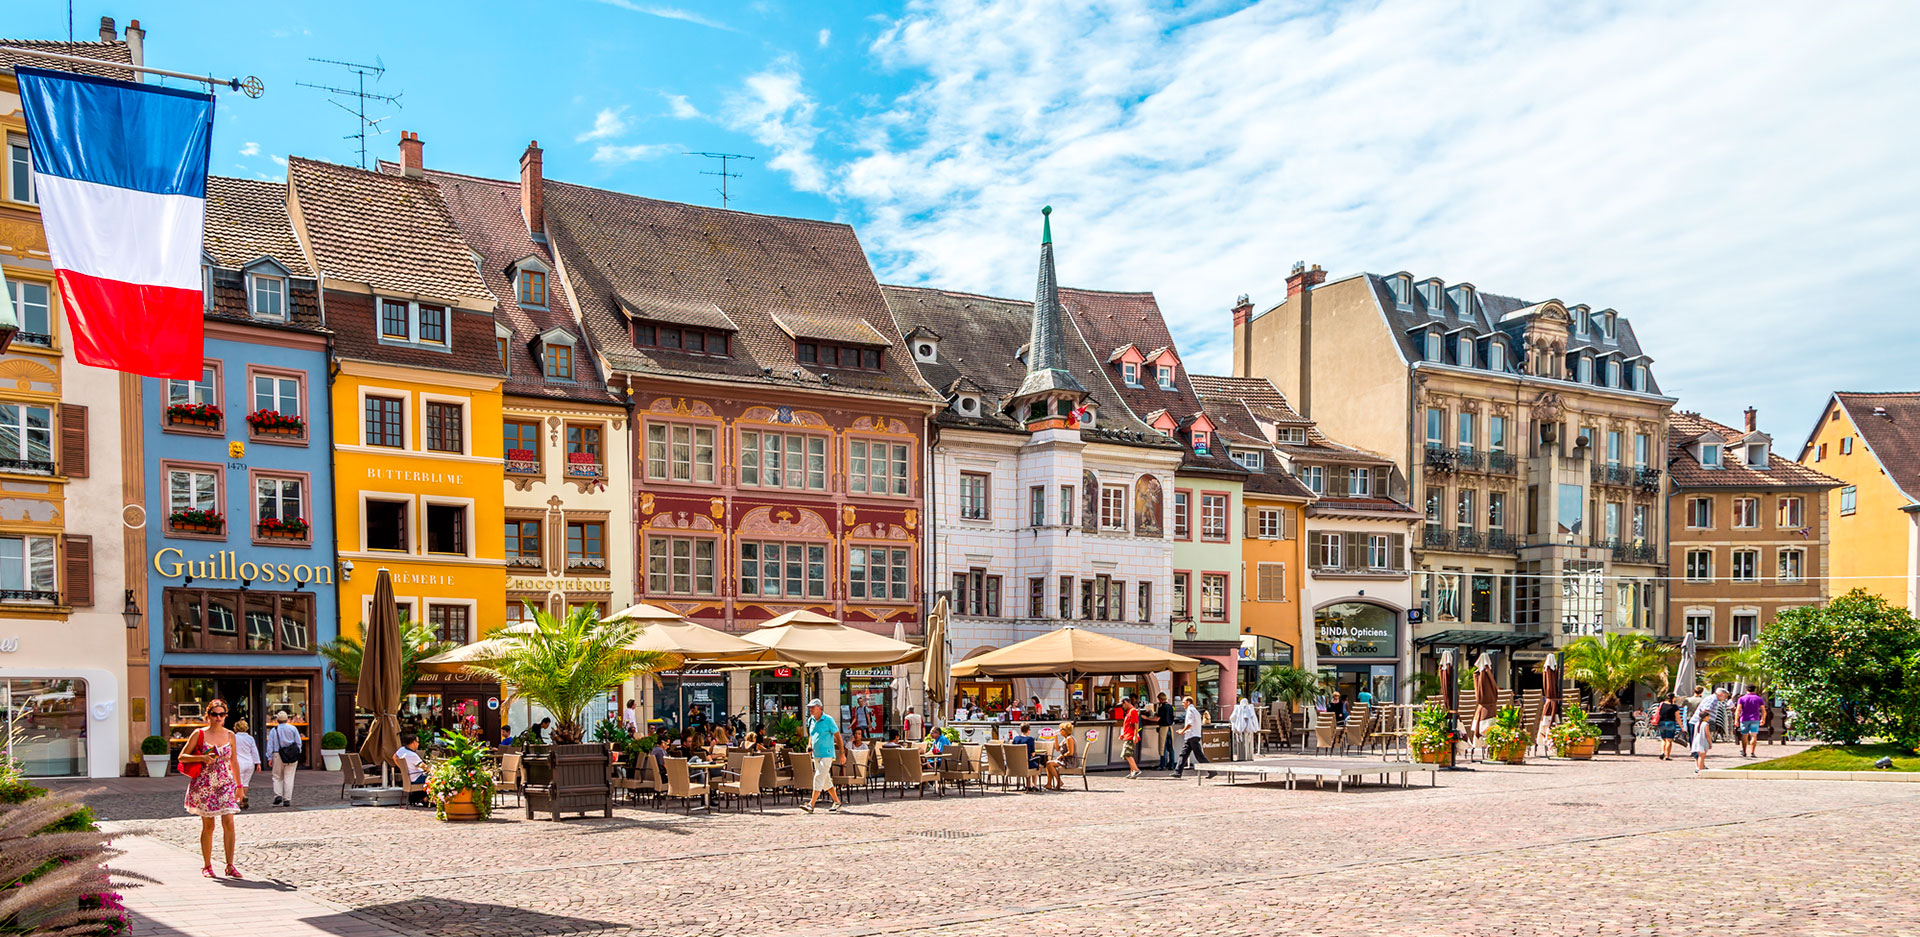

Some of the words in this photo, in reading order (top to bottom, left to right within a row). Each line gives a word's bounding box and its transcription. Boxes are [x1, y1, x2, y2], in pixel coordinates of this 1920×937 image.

[227, 462, 248, 470] 1479
[367, 467, 464, 485] BUTTERBLUME
[153, 547, 334, 585] Guillosson
[1320, 626, 1348, 636] BINDA
[1350, 627, 1388, 638] Opticiens
[1358, 645, 1378, 653] 2000
